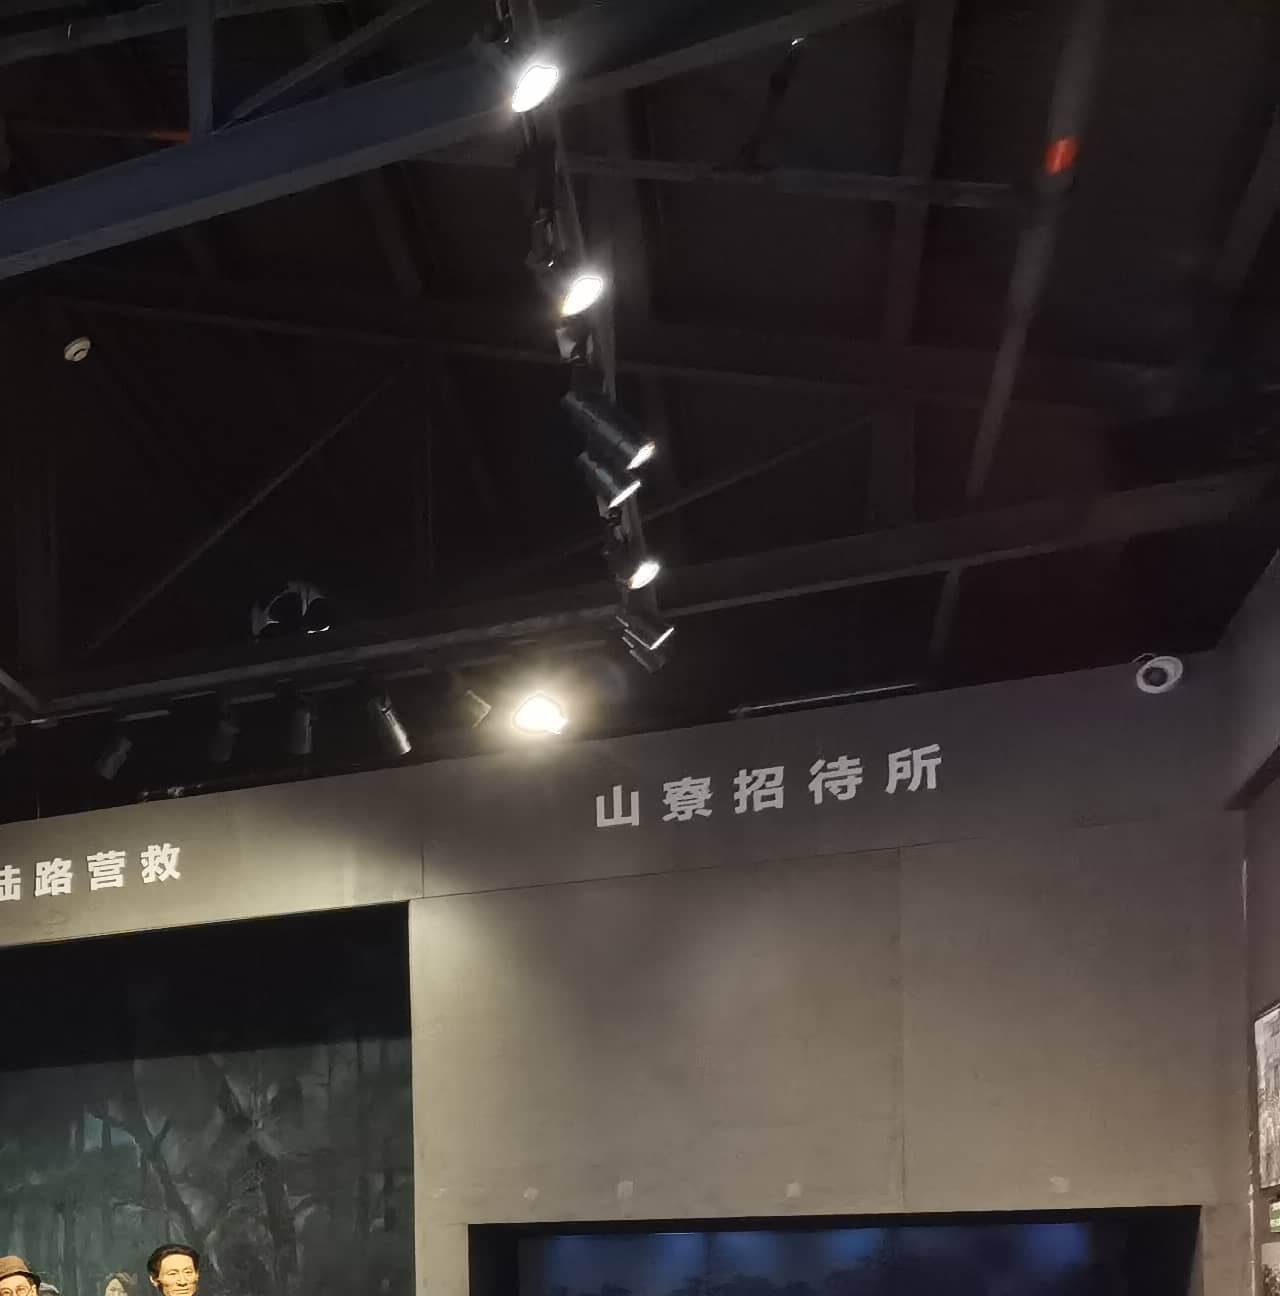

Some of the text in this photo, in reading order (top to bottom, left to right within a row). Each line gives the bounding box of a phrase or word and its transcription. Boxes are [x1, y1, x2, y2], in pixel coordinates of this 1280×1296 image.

[595, 743, 944, 829] 山寮招待所
